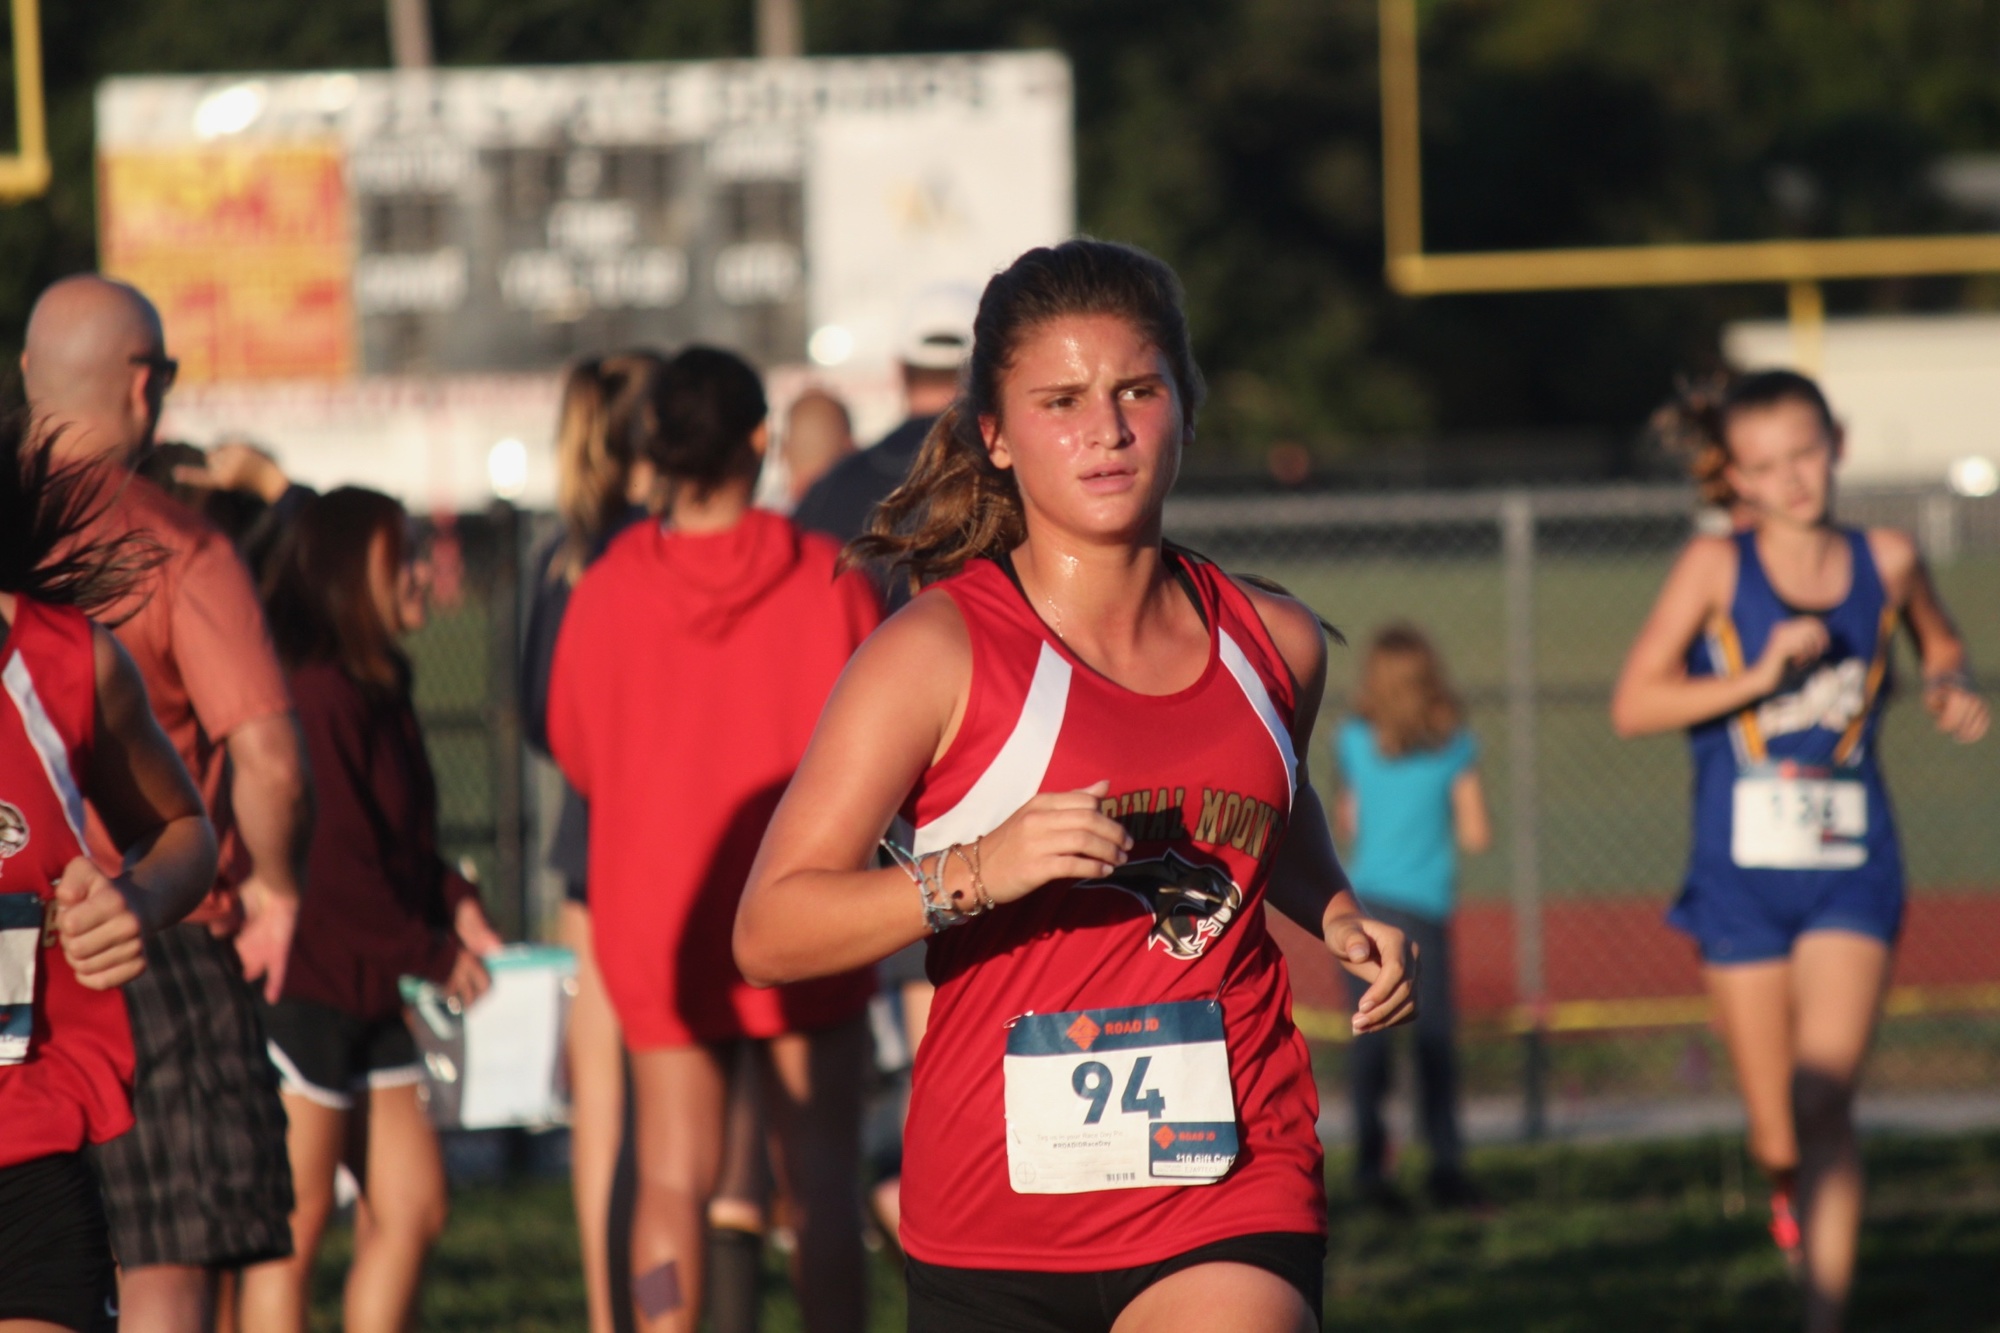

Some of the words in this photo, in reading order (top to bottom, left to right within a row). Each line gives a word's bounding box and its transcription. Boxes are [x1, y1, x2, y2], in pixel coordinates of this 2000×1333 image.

[1104, 1018, 1142, 1034] ROAD
[1071, 1055, 1166, 1125] 94
[1178, 1130, 1205, 1142] ROAD
[1194, 1152, 1212, 1164] Gift
